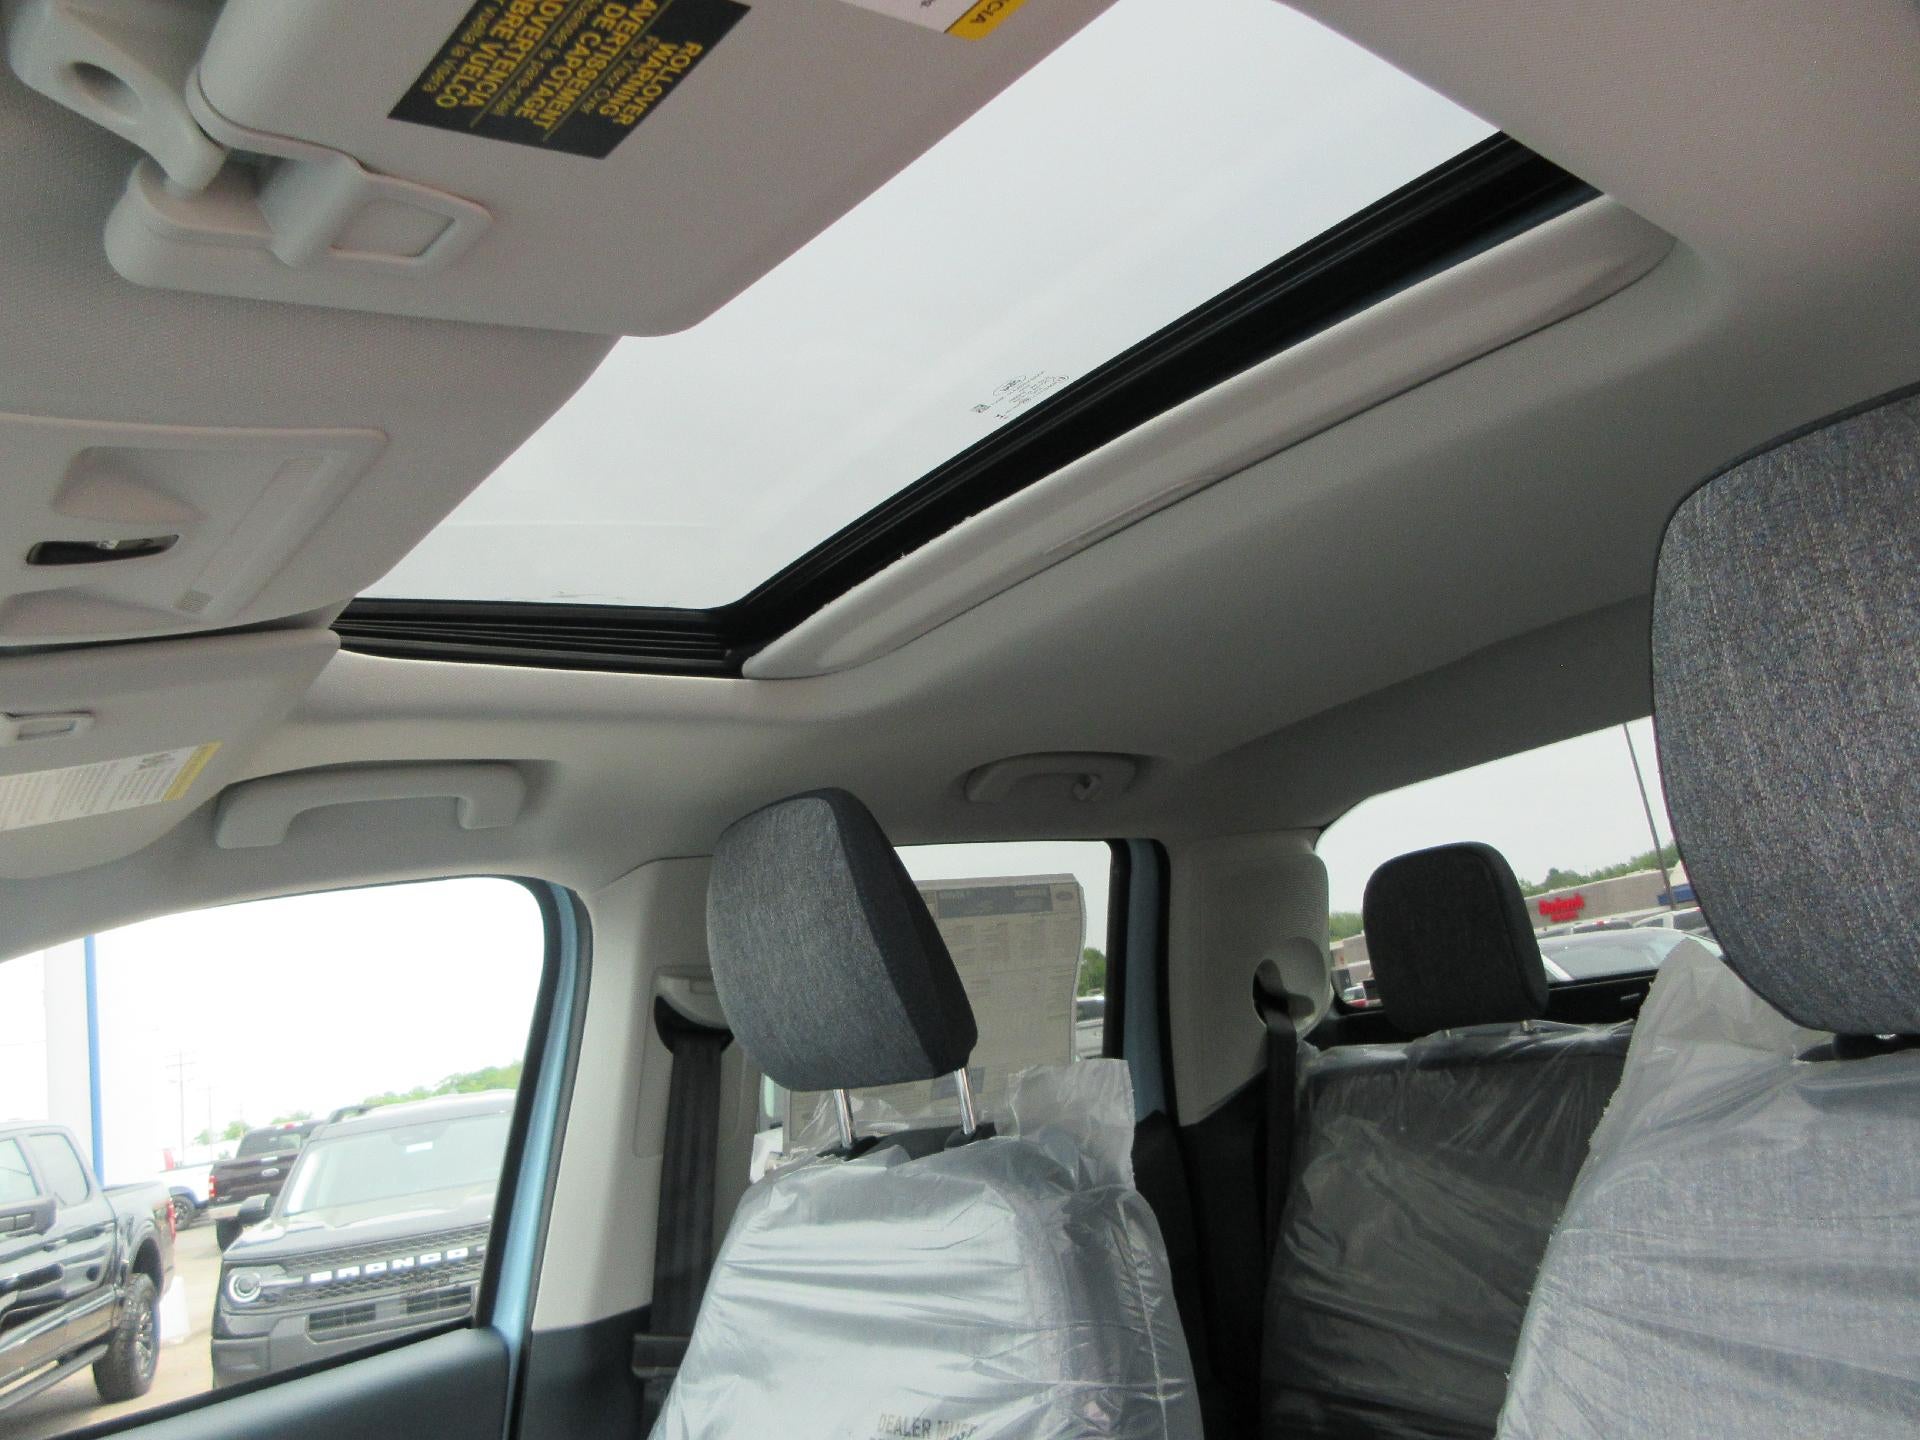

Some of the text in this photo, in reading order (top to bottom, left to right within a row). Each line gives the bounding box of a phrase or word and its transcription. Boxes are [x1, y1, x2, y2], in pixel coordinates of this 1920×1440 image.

[435, 0, 535, 108] BRE VUELCO
[461, 0, 564, 109] DVERTENCIA
[514, 3, 627, 119] DE CAPOTAGE
[533, 0, 657, 130] AVERTISSEMENT
[599, 42, 678, 116] WARNING
[612, 41, 703, 126] ROLLOVER
[877, 1412, 932, 1438] DEALER
